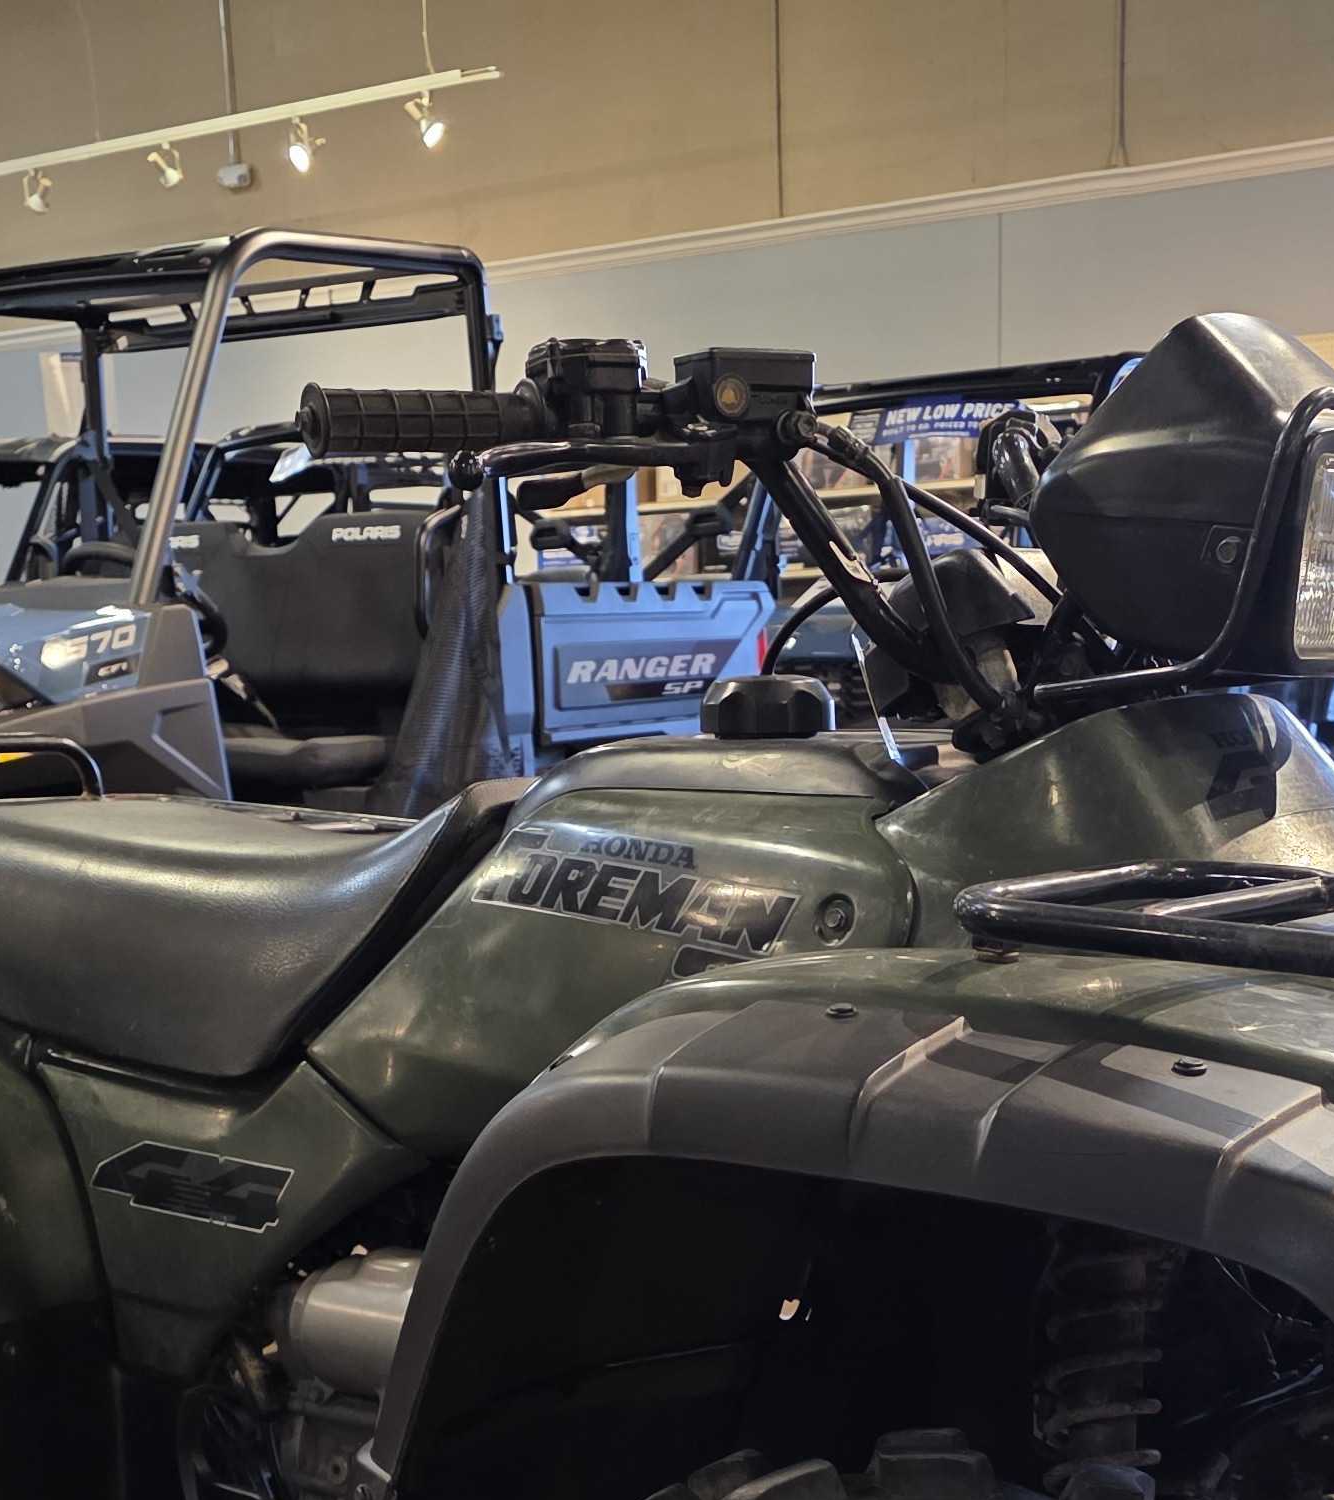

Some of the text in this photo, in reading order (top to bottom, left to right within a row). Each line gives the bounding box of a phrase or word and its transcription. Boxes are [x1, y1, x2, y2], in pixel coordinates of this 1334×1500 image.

[885, 408, 920, 427] NEW
[922, 405, 962, 421] LOW
[332, 525, 401, 541] POLARIS
[60, 624, 136, 662] 570
[567, 653, 716, 683] RANGER
[662, 680, 704, 695] SP
[580, 836, 696, 870] HONDA
